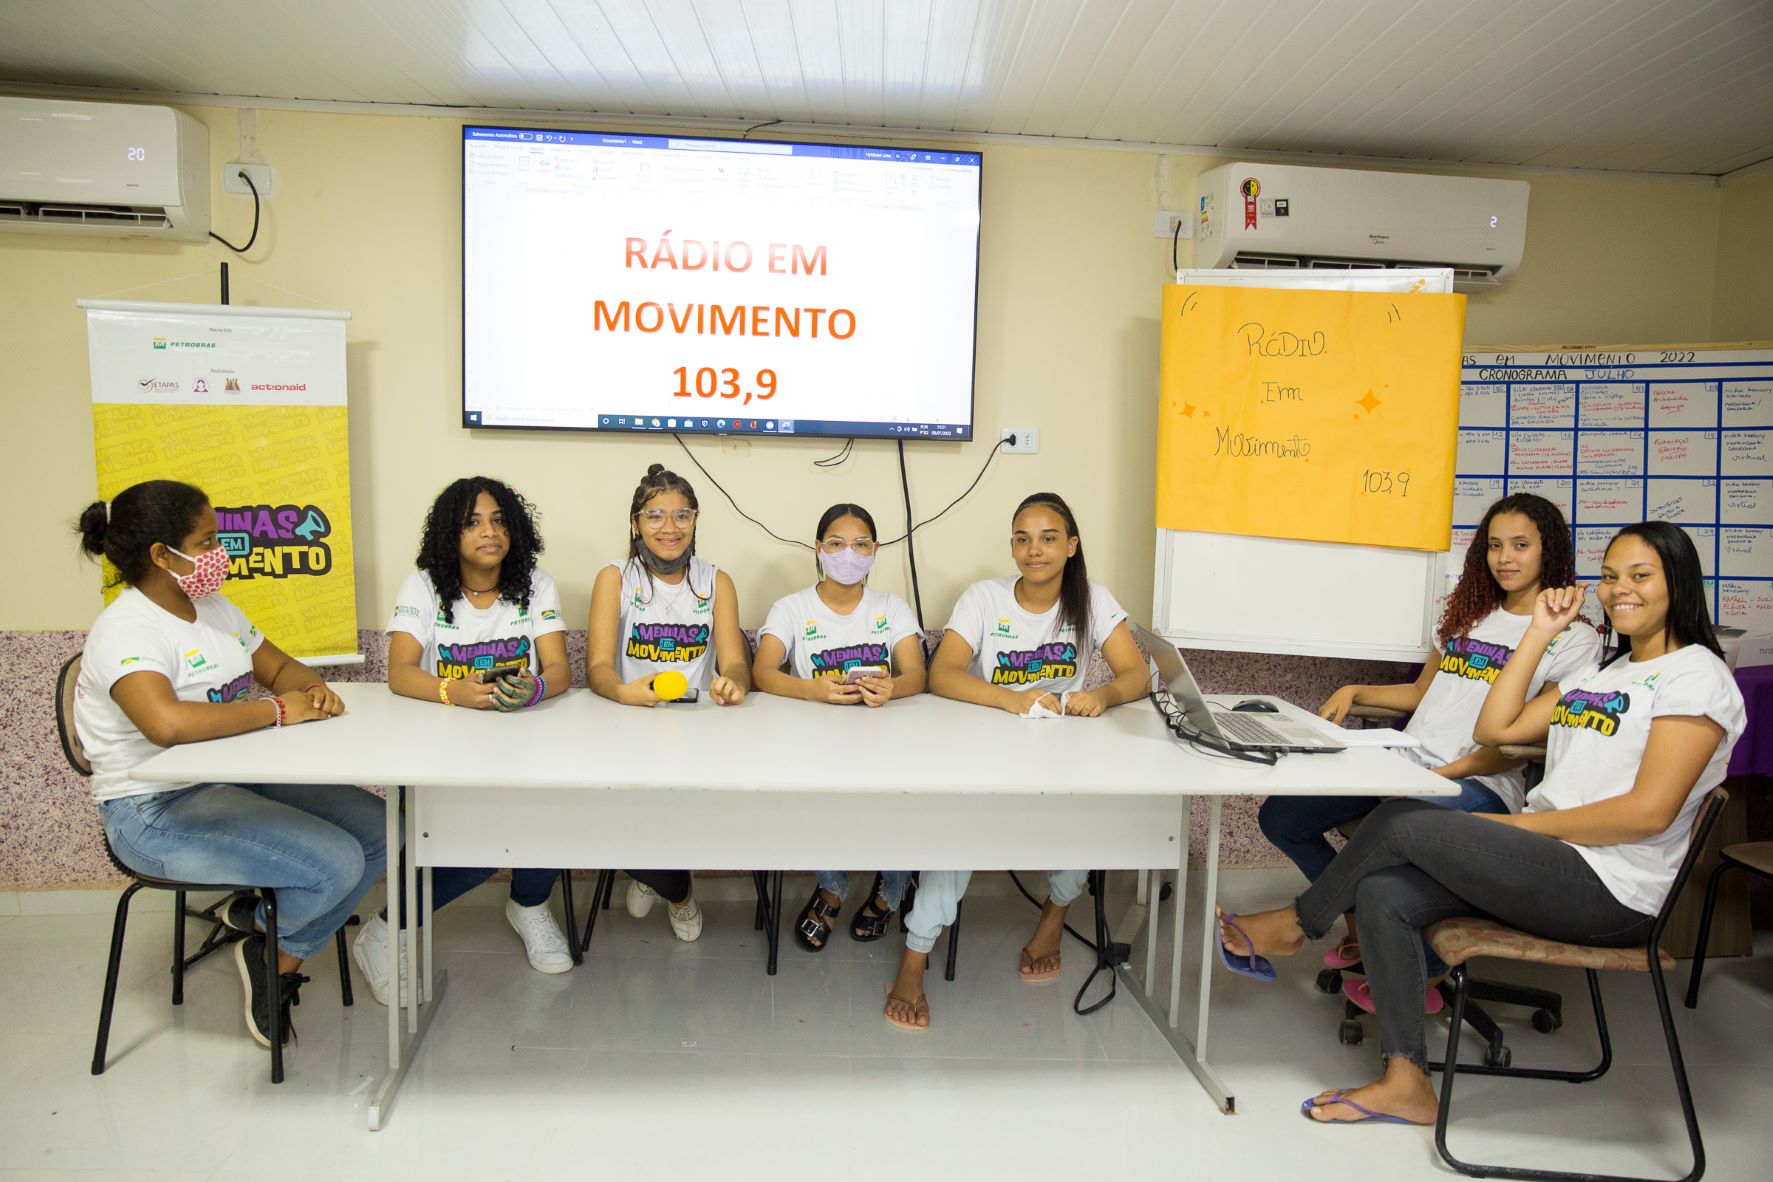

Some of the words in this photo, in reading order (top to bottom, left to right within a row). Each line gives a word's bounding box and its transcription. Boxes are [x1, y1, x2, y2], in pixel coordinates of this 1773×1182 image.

[127, 147, 145, 161] 20
[625, 229, 753, 274] RÁDIO
[768, 243, 827, 276] EM
[593, 300, 857, 340] MOVIMENTO
[1660, 351, 1696, 363] 2022
[1478, 368, 1568, 381] CRONOGRAMA
[1584, 369, 1635, 380] JULHO
[673, 366, 778, 406] 103,9
[1363, 469, 1411, 497] 103,9
[221, 538, 243, 551] EM
[639, 625, 699, 644] MENINAS
[451, 640, 519, 663] MENINAS
[627, 640, 706, 662] MOVIMENTO
[822, 646, 883, 667] MENINAS
